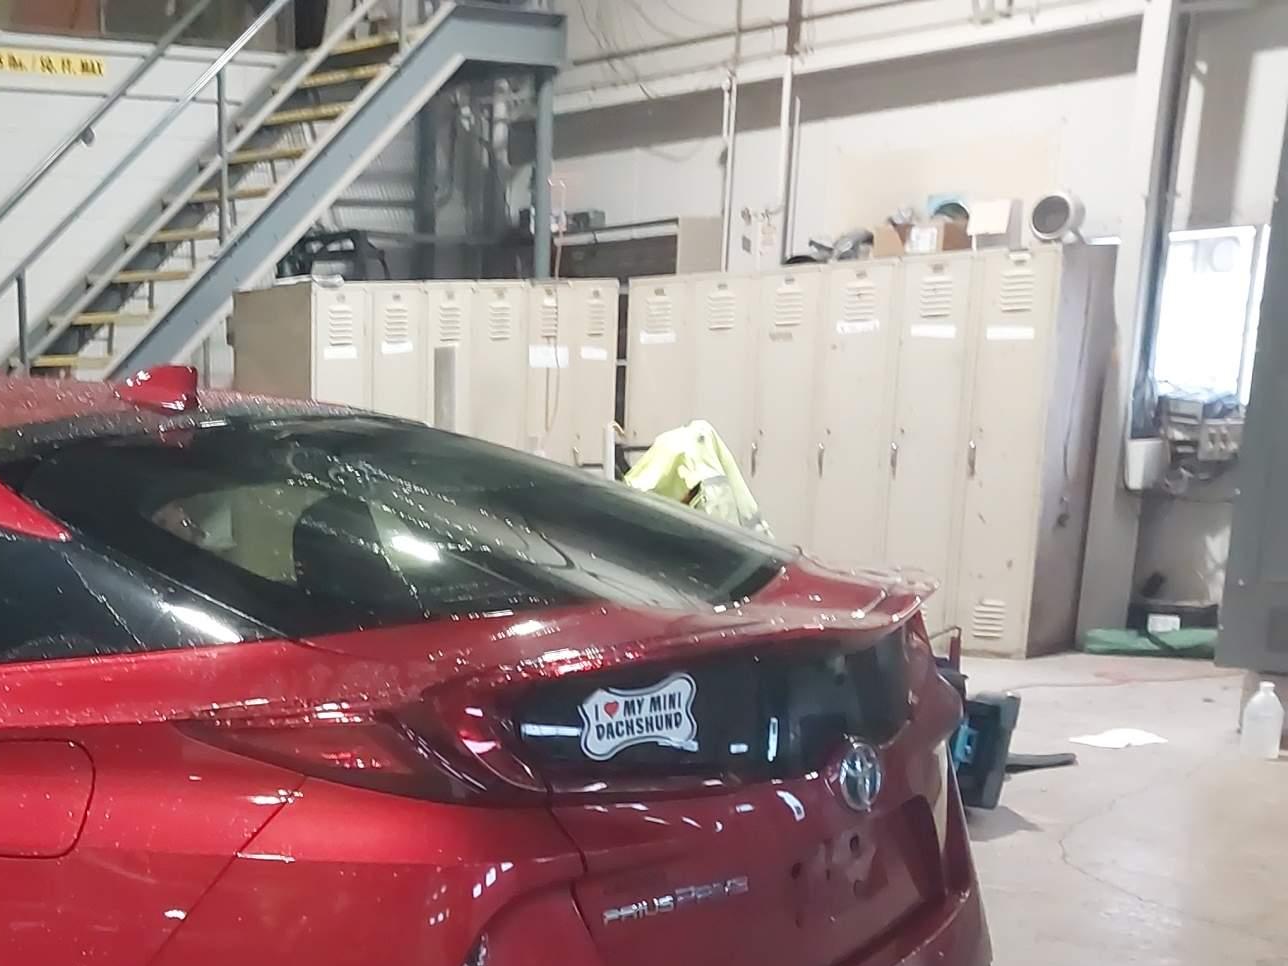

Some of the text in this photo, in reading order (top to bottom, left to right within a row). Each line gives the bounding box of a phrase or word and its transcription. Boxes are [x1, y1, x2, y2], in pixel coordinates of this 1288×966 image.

[80, 60, 103, 76] MAX
[595, 691, 682, 721] I MY MINI
[595, 711, 683, 741] DACHSHUND
